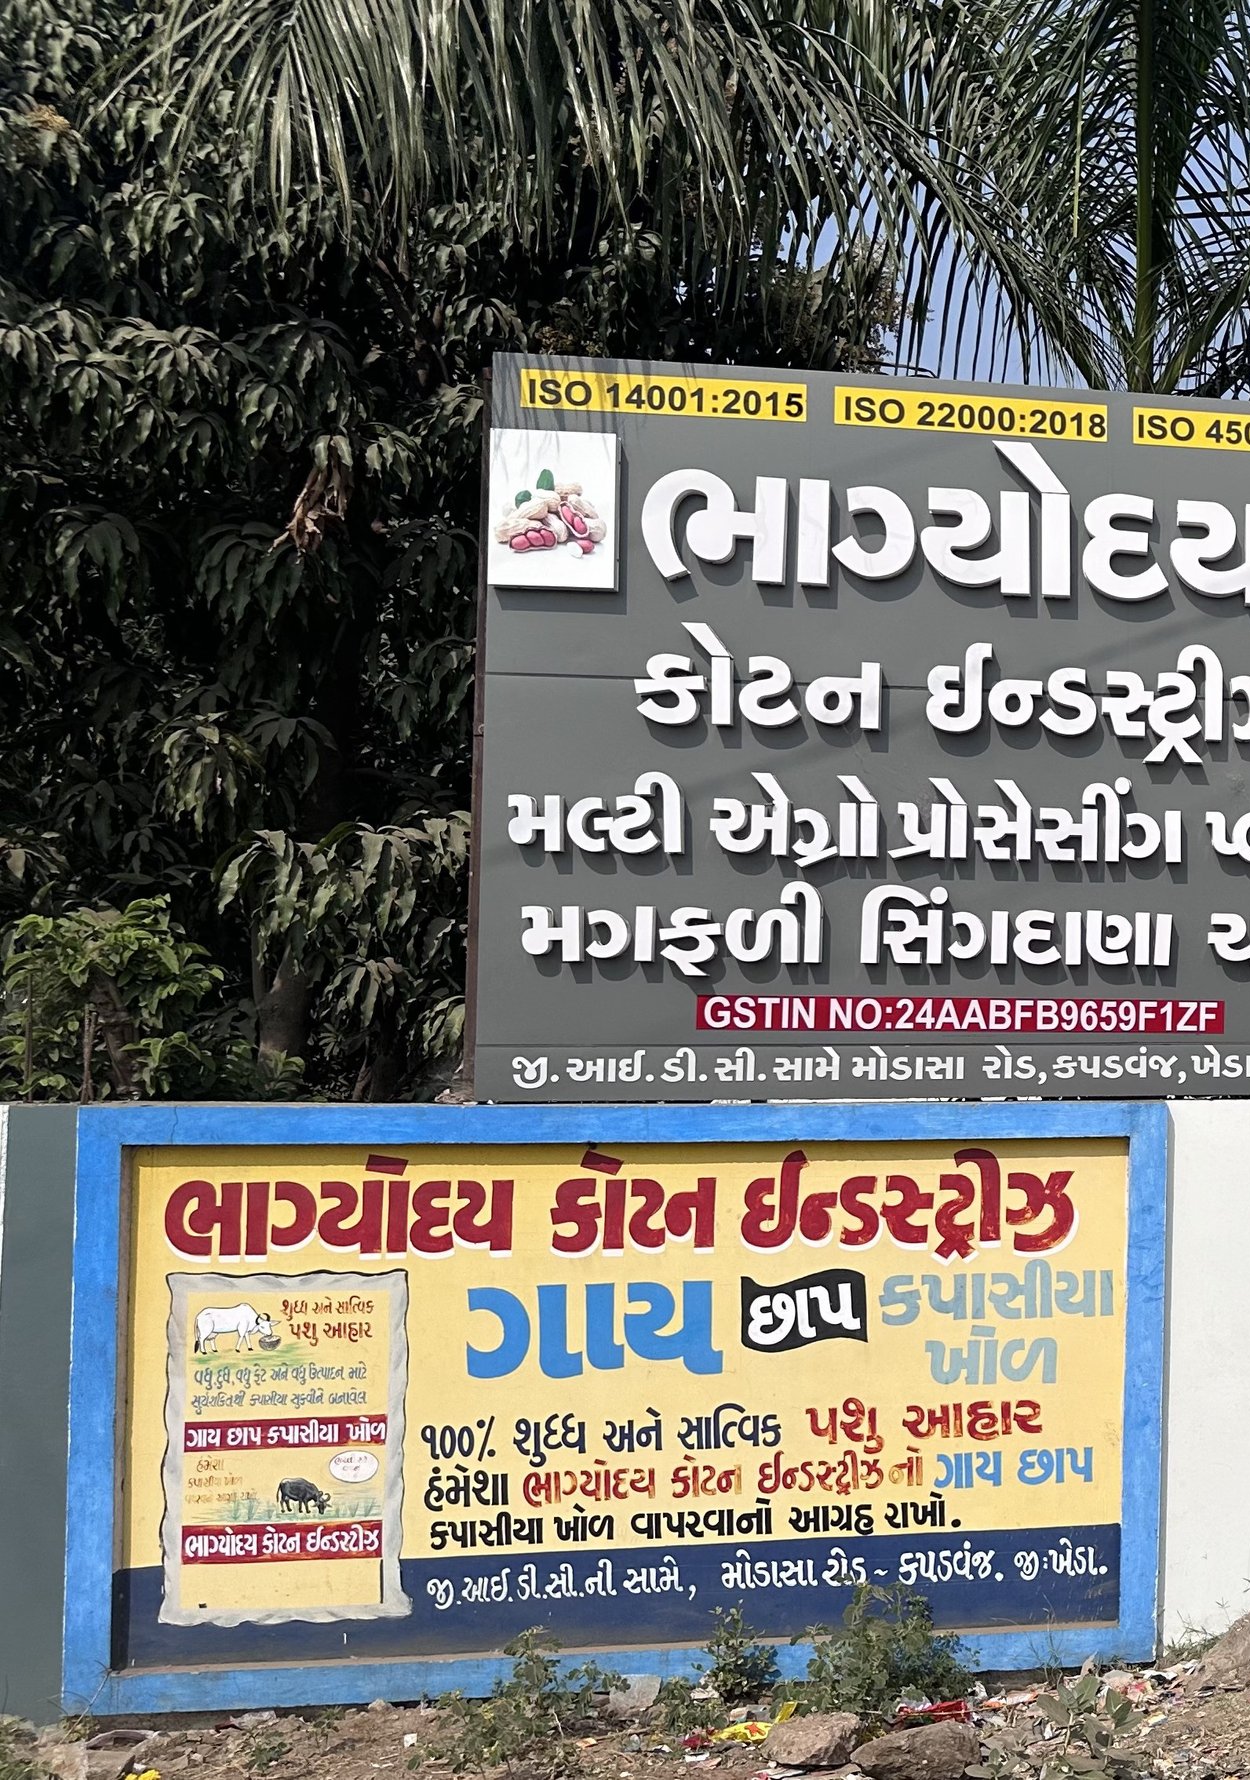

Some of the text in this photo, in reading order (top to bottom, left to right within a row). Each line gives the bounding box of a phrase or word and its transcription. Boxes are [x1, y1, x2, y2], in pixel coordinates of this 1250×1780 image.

[528, 378, 803, 419] ISO 14001:2015
[844, 396, 1107, 438] ISO 22000:2018
[1137, 414, 1195, 441] ISO
[634, 622, 882, 730] કોટન
[507, 771, 685, 854] મલ્ટી
[709, 772, 879, 868] એગ્રો
[888, 776, 1182, 863] પ્રોસેસીંગ
[520, 881, 824, 976] મગફળી
[860, 884, 1173, 966] સિંગદાણા
[703, 998, 816, 1030] GSTIN
[851, 1046, 965, 1082] મોડાસા
[164, 1147, 1079, 1263] ભાગ્યોદય કોટન ઈન્ડસ્ટ્રીઝ
[312, 1296, 332, 1314] અને
[466, 1259, 1115, 1379] ગાય છાપ કપાસીયા
[289, 1322, 373, 1347] પશુ આહાર
[925, 1325, 1058, 1385] ખોળ
[186, 1416, 386, 1447] ગાય છાપ કપાસીયા ખોળ
[603, 1407, 663, 1453] અને
[677, 1402, 782, 1451] સાત્વિક
[805, 1397, 885, 1454] પશુ
[902, 1399, 1043, 1441] આહાર
[424, 1464, 509, 1512] હંમેશા
[523, 1459, 656, 1508] ભાગ્યોદય
[672, 1455, 743, 1499] કોટન
[933, 1450, 1002, 1489] ગાય
[1017, 1446, 1094, 1486] છાપ
[185, 1526, 257, 1557] ભાગ્યોદય
[262, 1525, 300, 1554] કોટન
[430, 1511, 543, 1551] કપાસીયા
[554, 1503, 615, 1543] ખોળ
[630, 1497, 773, 1540] વાપરવાનો
[788, 1502, 874, 1535] આગ્રહ
[720, 1548, 818, 1589] મોડાસા
[821, 1546, 867, 1586] રોડ
